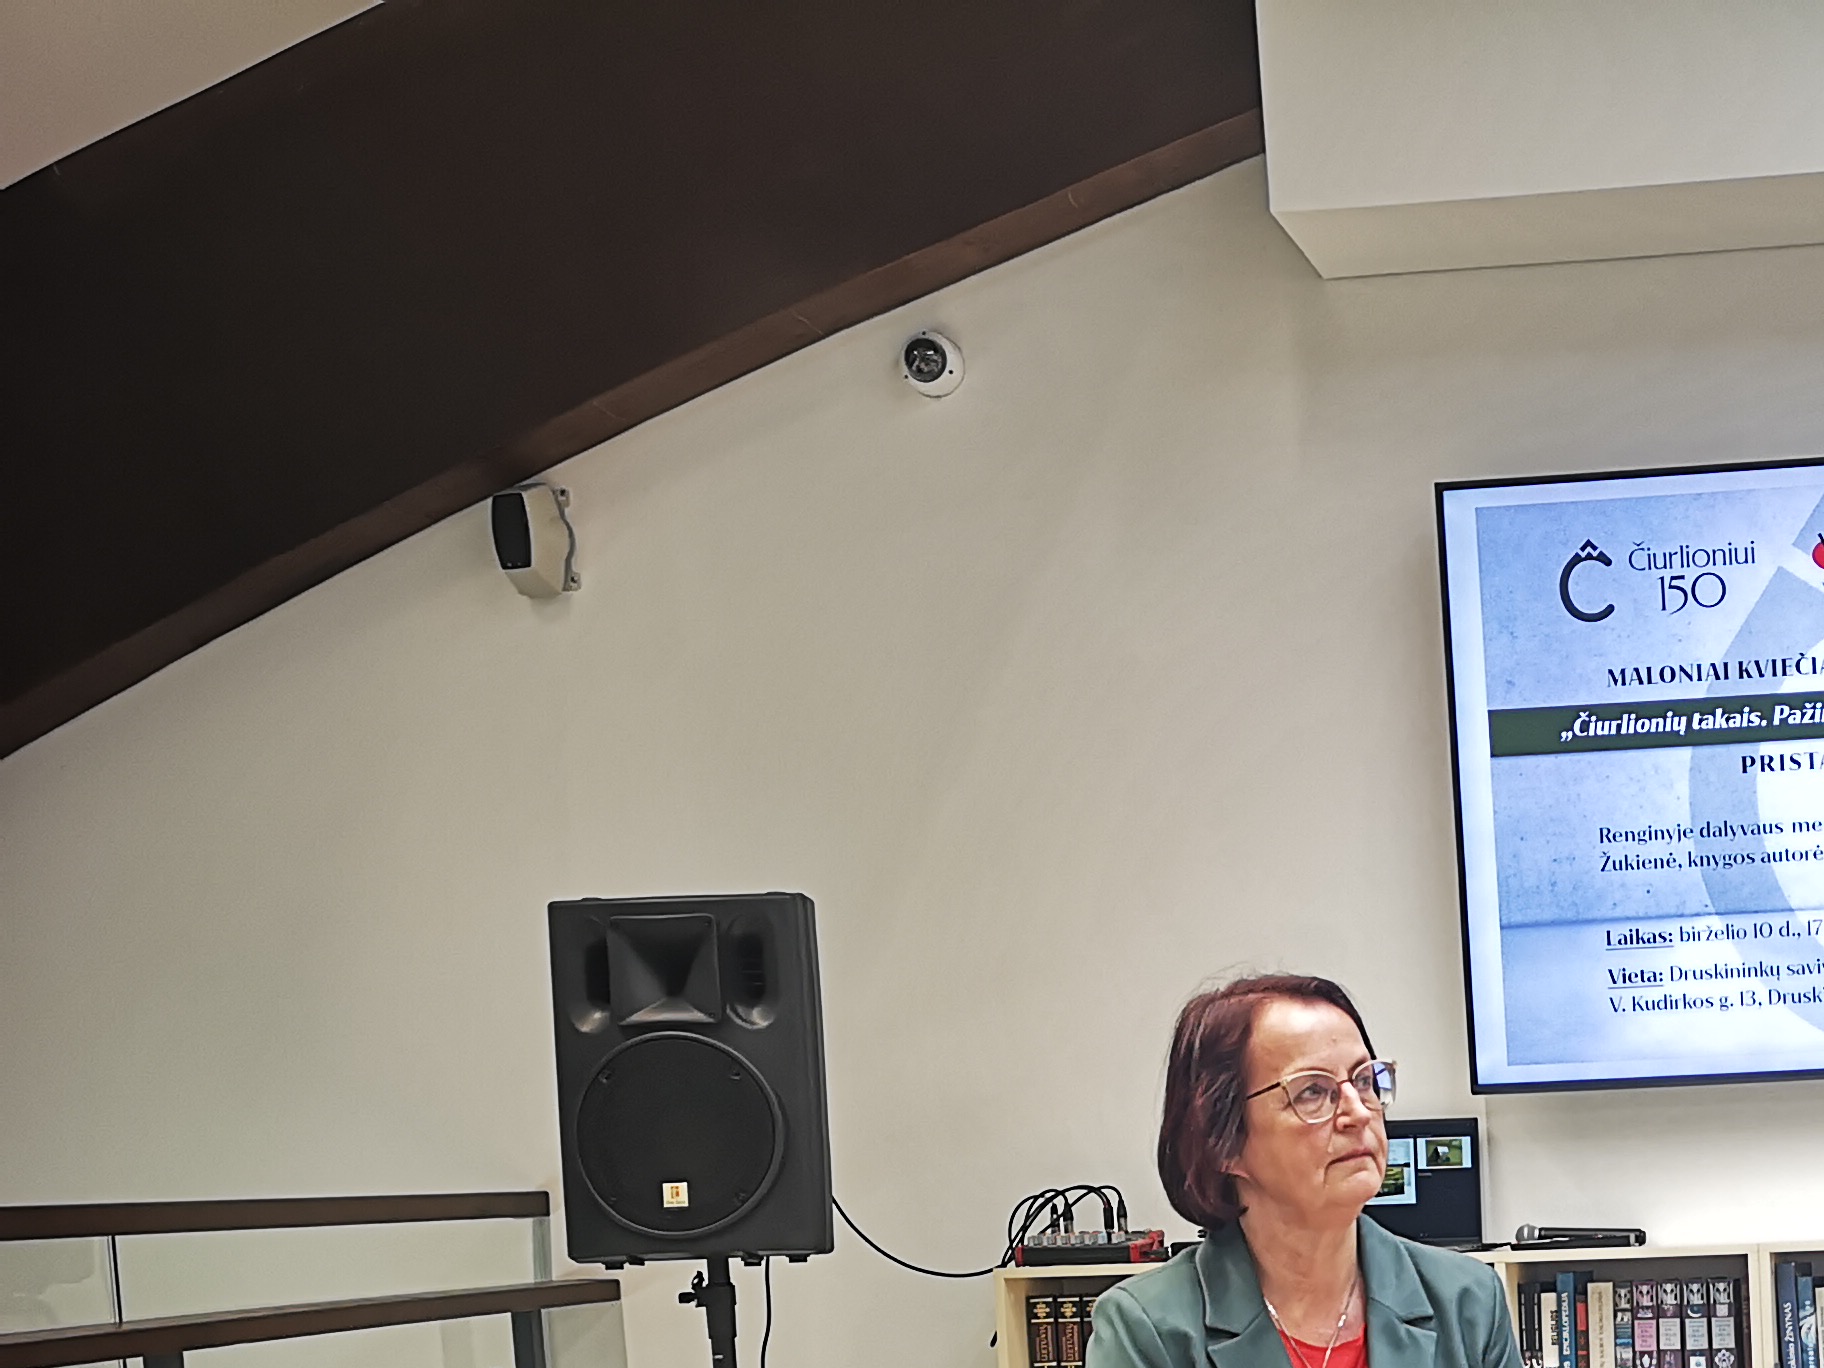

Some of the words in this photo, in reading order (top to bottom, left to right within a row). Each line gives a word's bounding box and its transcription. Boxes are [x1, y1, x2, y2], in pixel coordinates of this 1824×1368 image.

[1628, 540, 1756, 572] Čiurlioniui
[1658, 572, 1727, 615] 150
[1606, 661, 1731, 688] MALONIAI
[1690, 706, 1767, 731] takais.
[1598, 824, 1695, 846] Renginyje
[1699, 819, 1784, 843] dalyvaus
[1599, 851, 1683, 873] Žukienė,
[1687, 847, 1756, 869] knygos
[1760, 843, 1824, 864] autorė
[1605, 928, 1674, 947] Laikas:
[1679, 920, 1748, 943] birželio
[1752, 920, 1774, 940] 10
[1778, 919, 1802, 940] d.,
[1607, 966, 1664, 985] Vieta:
[1668, 961, 1781, 983] Druskininkų
[1609, 995, 1626, 1013] V.
[1631, 991, 1714, 1013] Kudirkos
[1718, 992, 1734, 1011] g.
[1739, 988, 1763, 1010] 13,
[1783, 1301, 1795, 1342] ŽINYNAS
